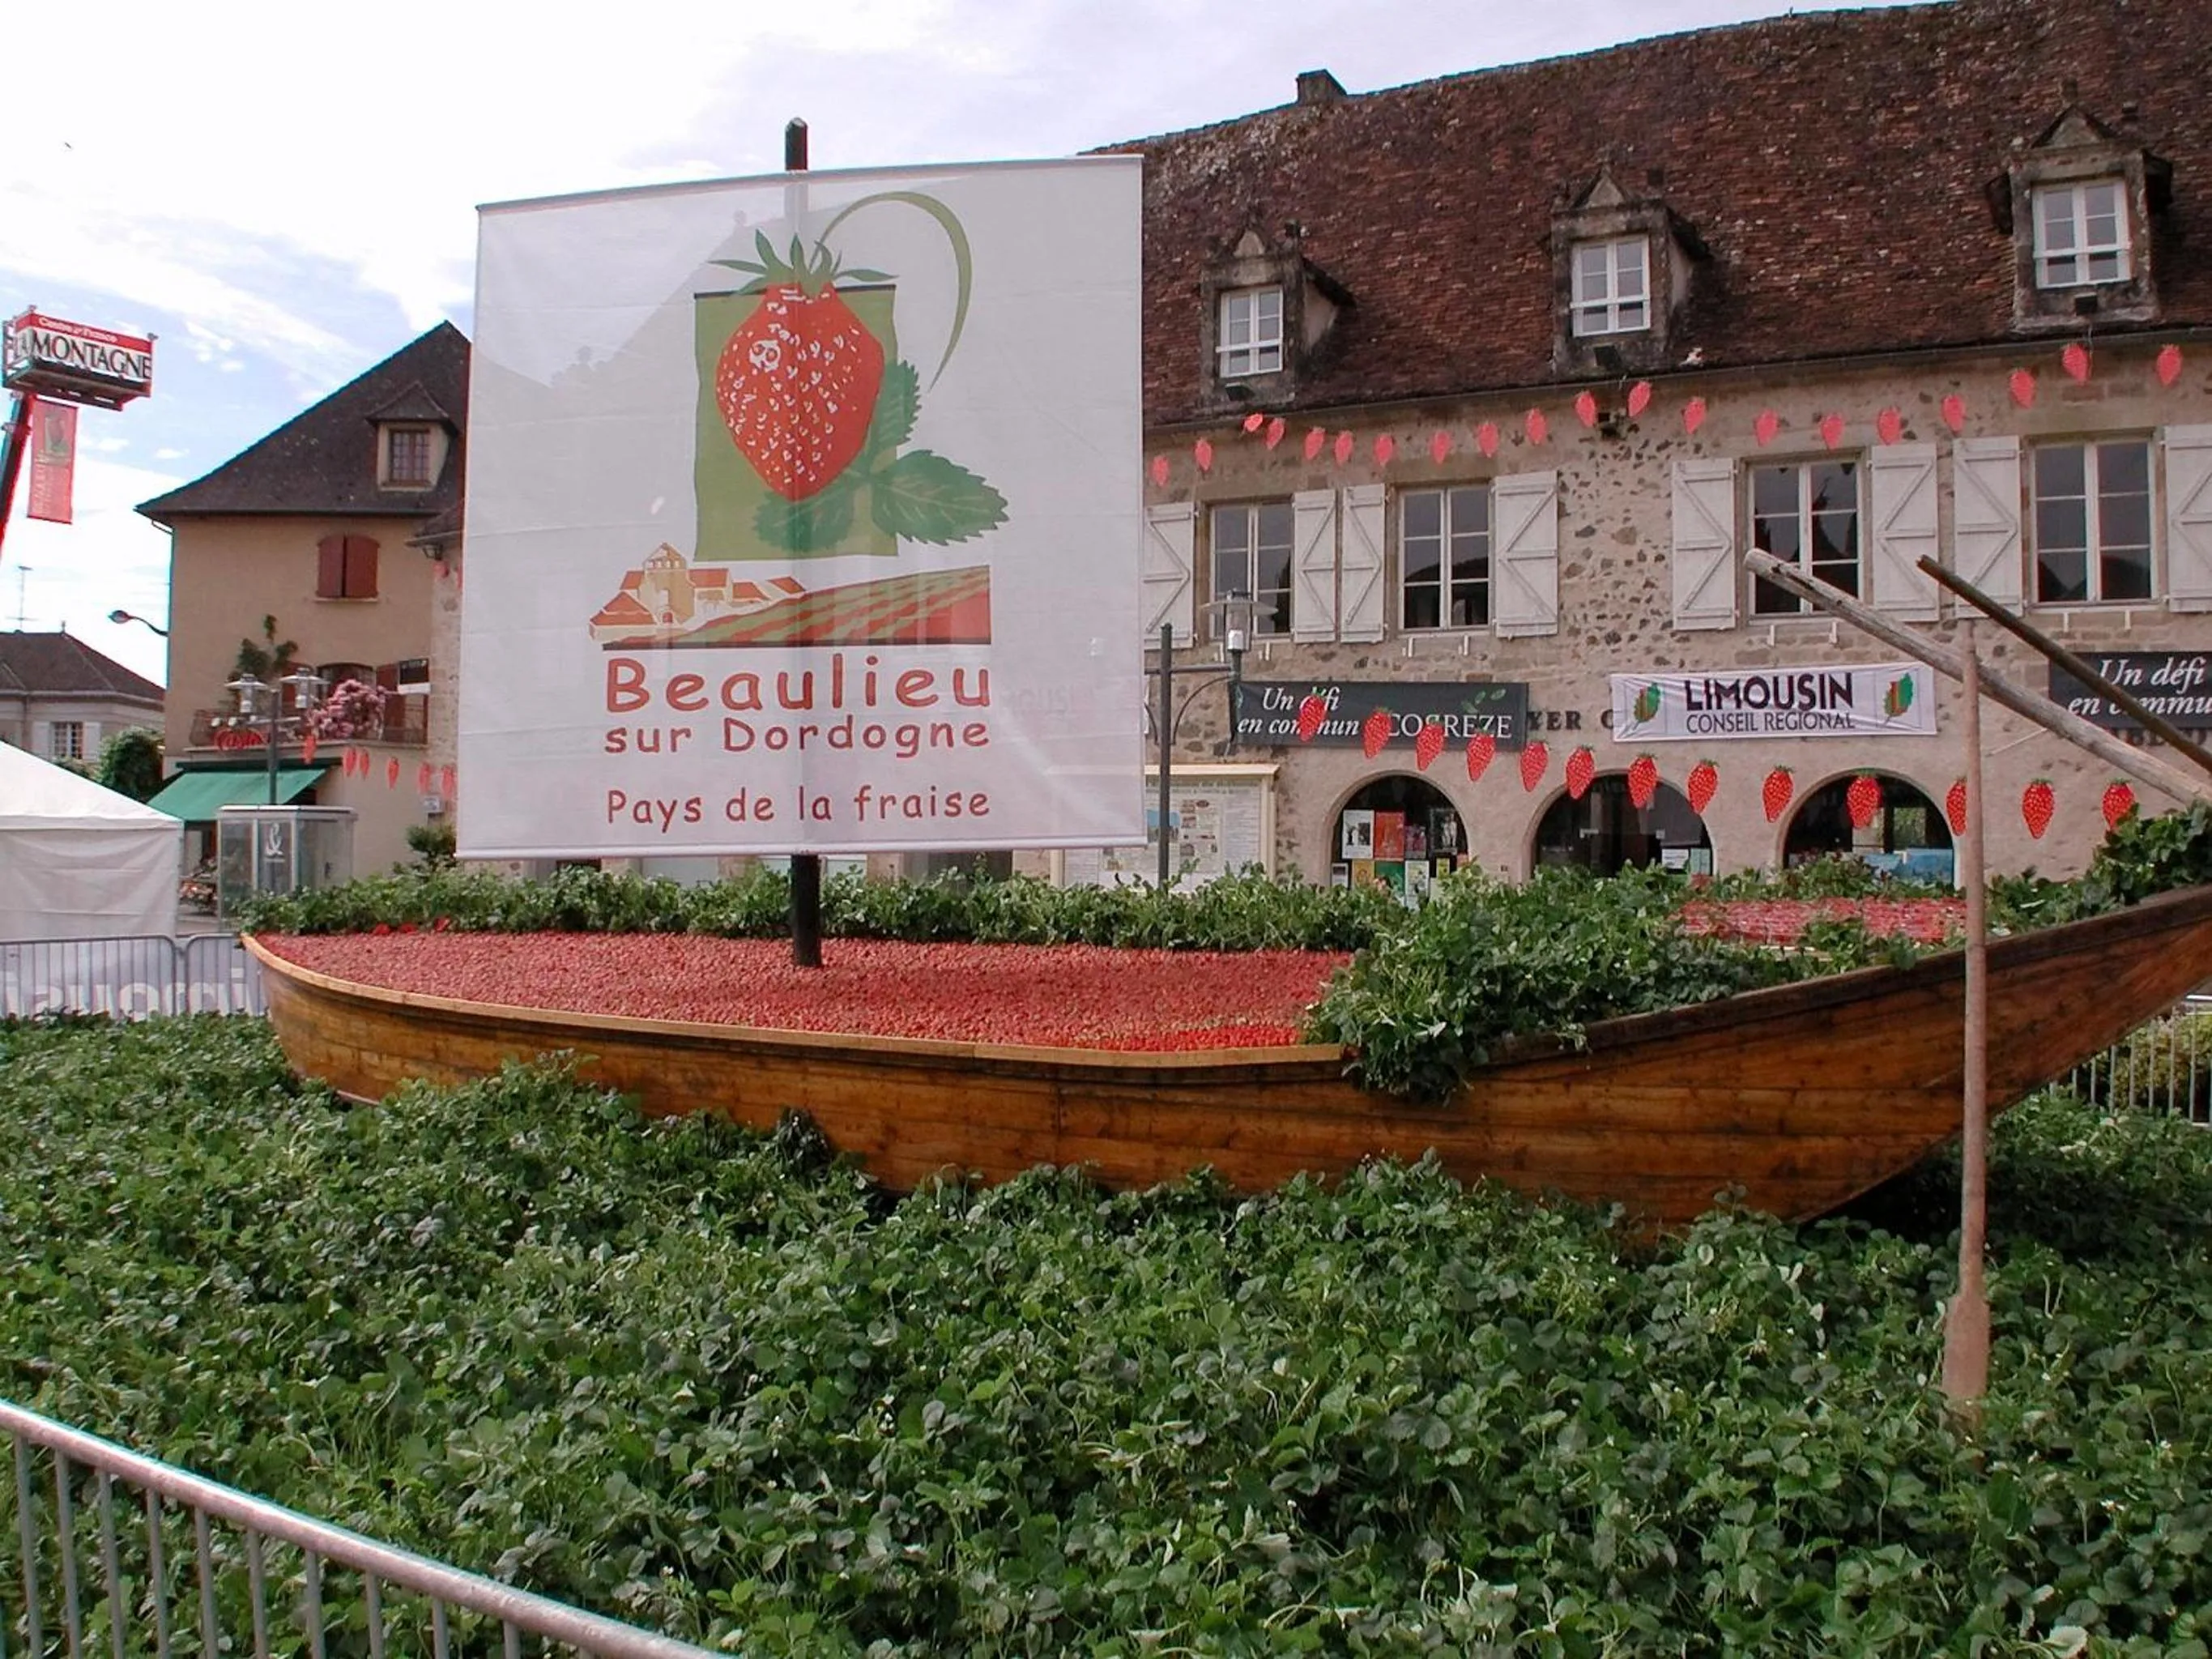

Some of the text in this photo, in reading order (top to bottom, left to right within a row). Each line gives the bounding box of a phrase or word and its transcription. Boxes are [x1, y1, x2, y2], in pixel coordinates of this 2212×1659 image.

[31, 329, 151, 379] MONTAGNE
[607, 653, 991, 713] Beaulieu
[1684, 672, 1854, 712] LIMOUSIN
[2099, 656, 2206, 694] Un défi
[1263, 687, 1294, 710] Un
[2068, 696, 2100, 715] en
[604, 714, 990, 758] sur Dordogne
[1238, 718, 1263, 734] en
[1686, 710, 1856, 734] CONSEIL REGIONAL
[607, 785, 991, 834] Pays de la fraise
